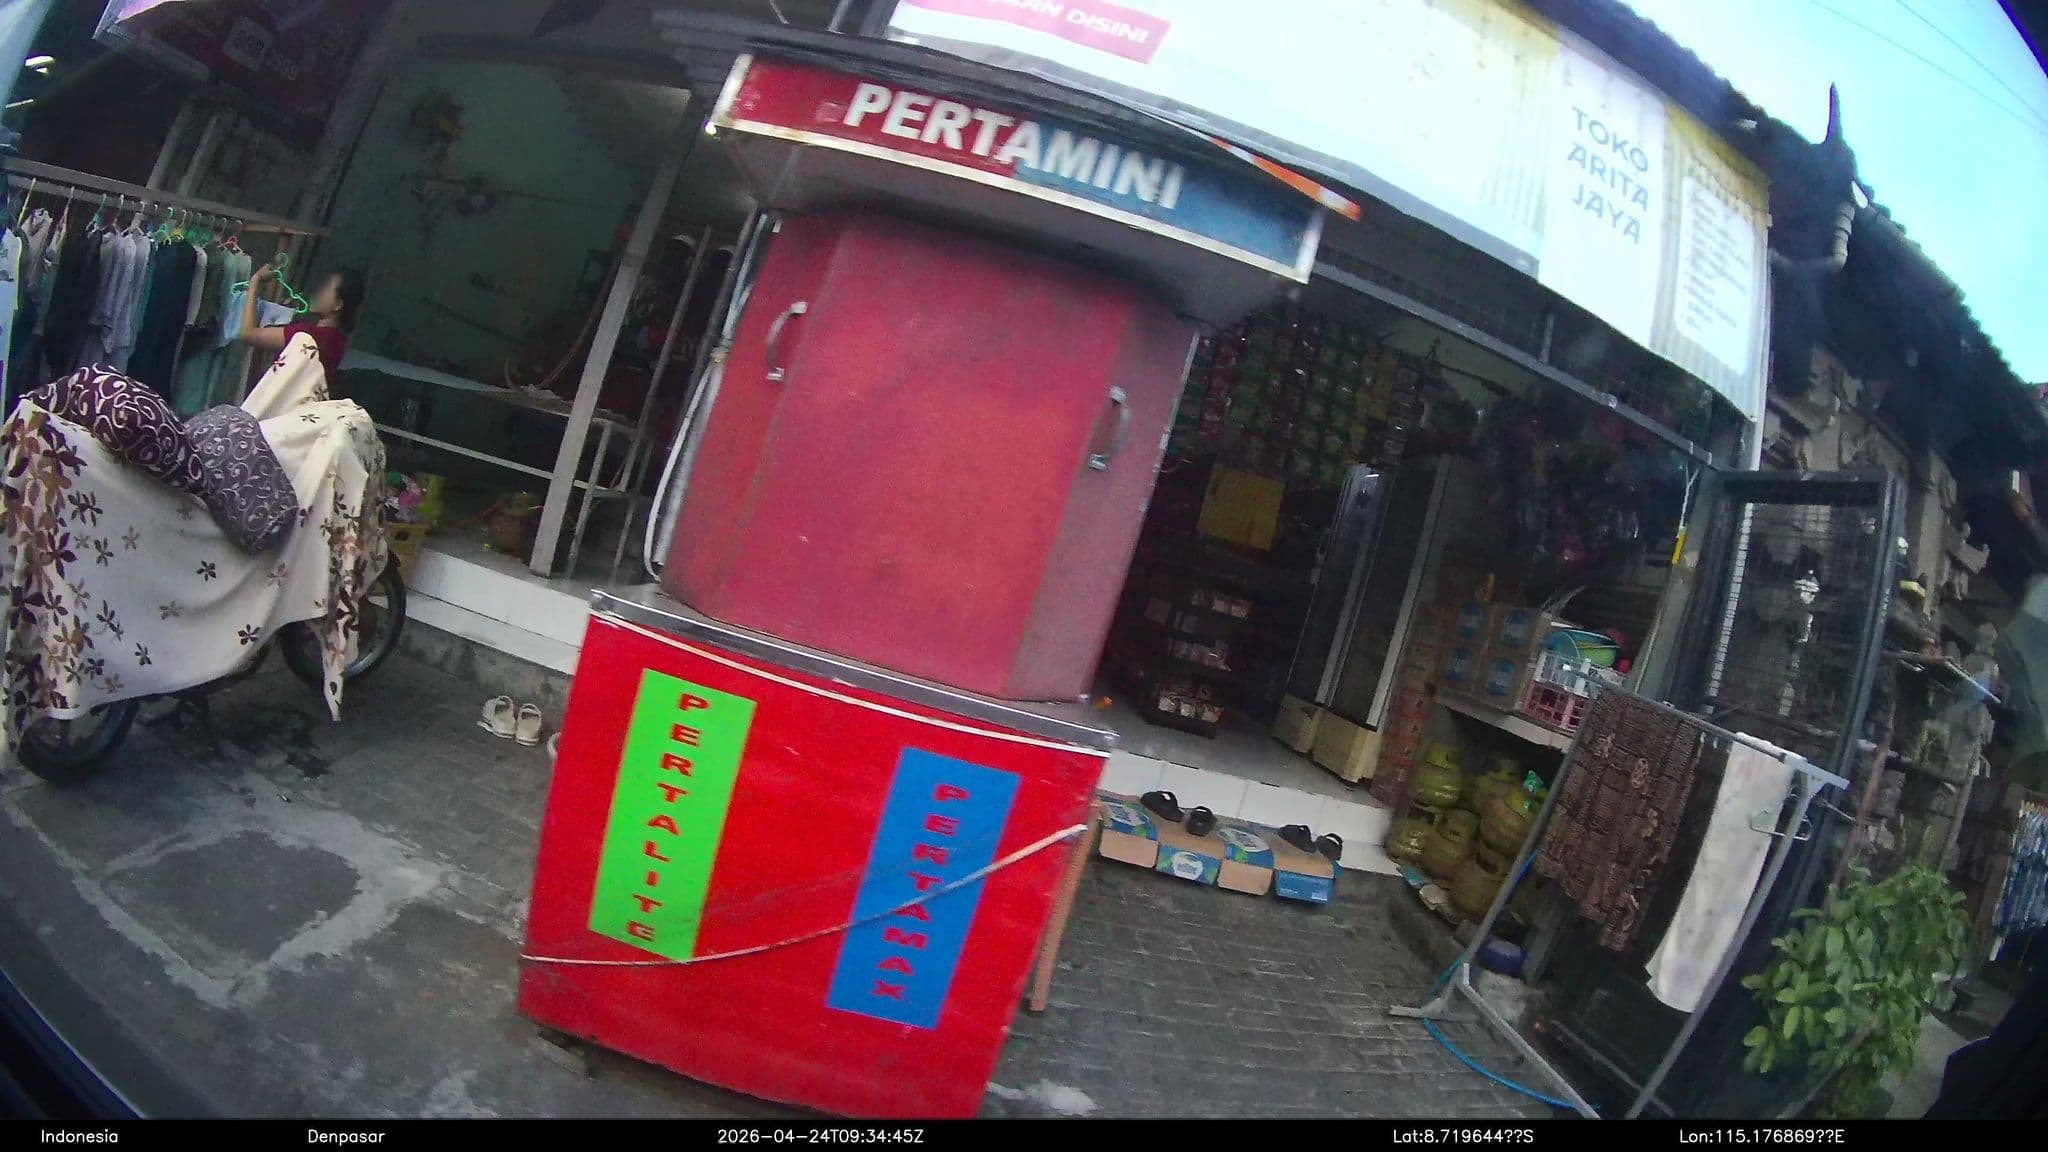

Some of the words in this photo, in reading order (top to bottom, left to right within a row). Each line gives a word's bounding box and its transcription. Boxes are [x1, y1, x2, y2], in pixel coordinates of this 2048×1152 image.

[1066, 8, 1149, 43] DISINI
[843, 82, 1184, 210] PERTAMINI
[1572, 105, 1649, 173] TOKO
[1568, 142, 1649, 212] ARITA
[1572, 184, 1641, 244] JAYA
[626, 693, 711, 942] PERTALITE
[870, 783, 970, 1001] PERTAMAX
